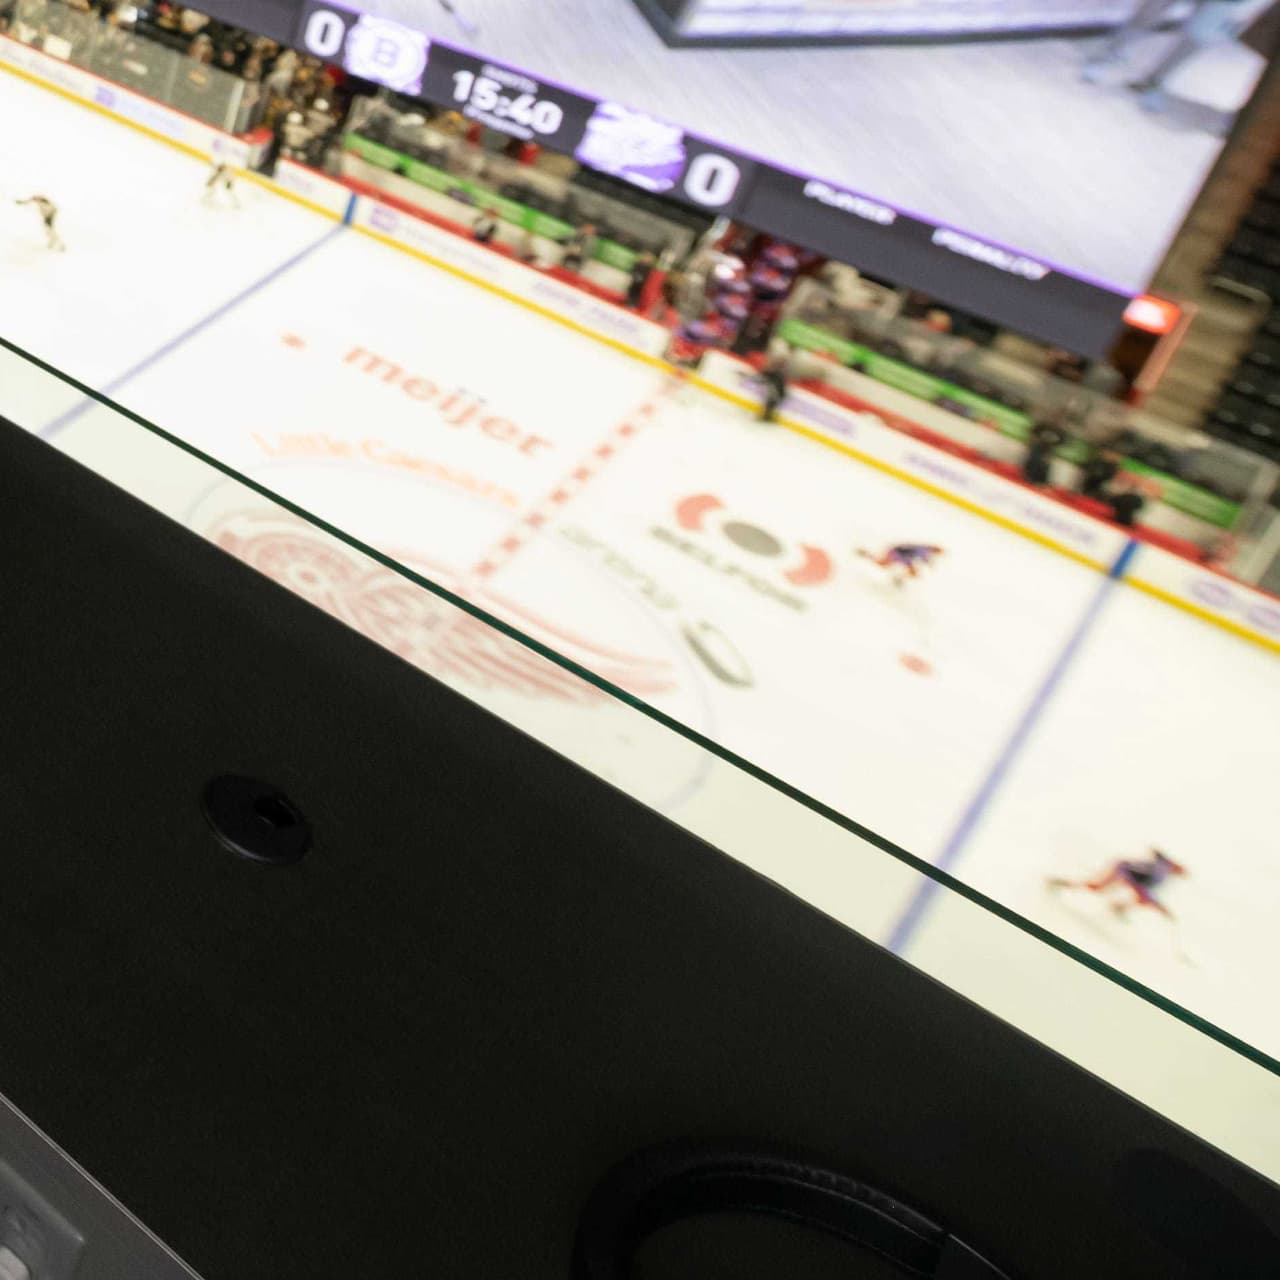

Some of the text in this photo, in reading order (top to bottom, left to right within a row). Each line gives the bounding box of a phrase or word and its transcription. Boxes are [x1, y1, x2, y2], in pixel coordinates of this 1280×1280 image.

[304, 9, 346, 58] 0
[451, 69, 564, 136] 15:40
[682, 152, 740, 208] 0
[342, 345, 558, 457] meijer
